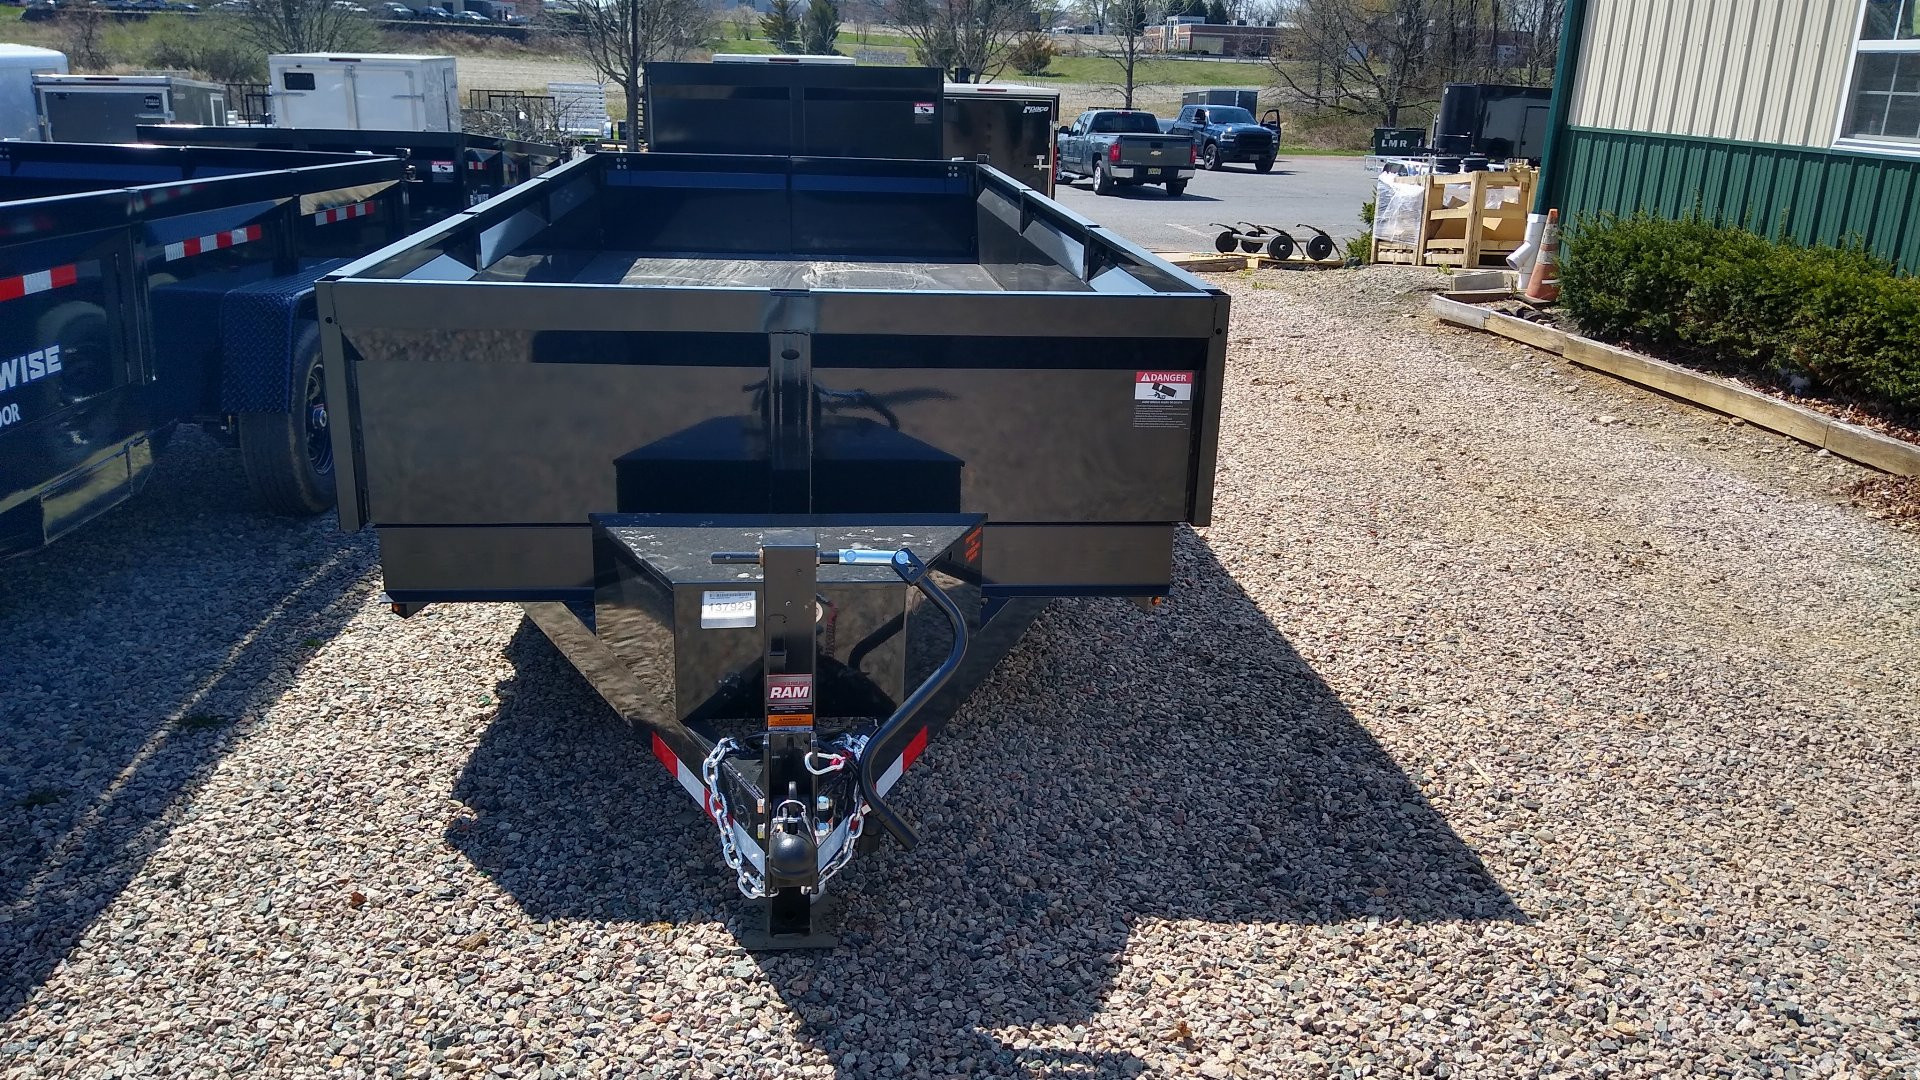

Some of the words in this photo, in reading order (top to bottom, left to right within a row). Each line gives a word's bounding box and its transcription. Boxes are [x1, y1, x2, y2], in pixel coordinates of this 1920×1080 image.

[1381, 139, 1408, 148] LMR
[0, 345, 62, 392] WISE
[1150, 373, 1187, 382] DANGER
[709, 601, 753, 612] 137929
[770, 686, 809, 699] RAM
